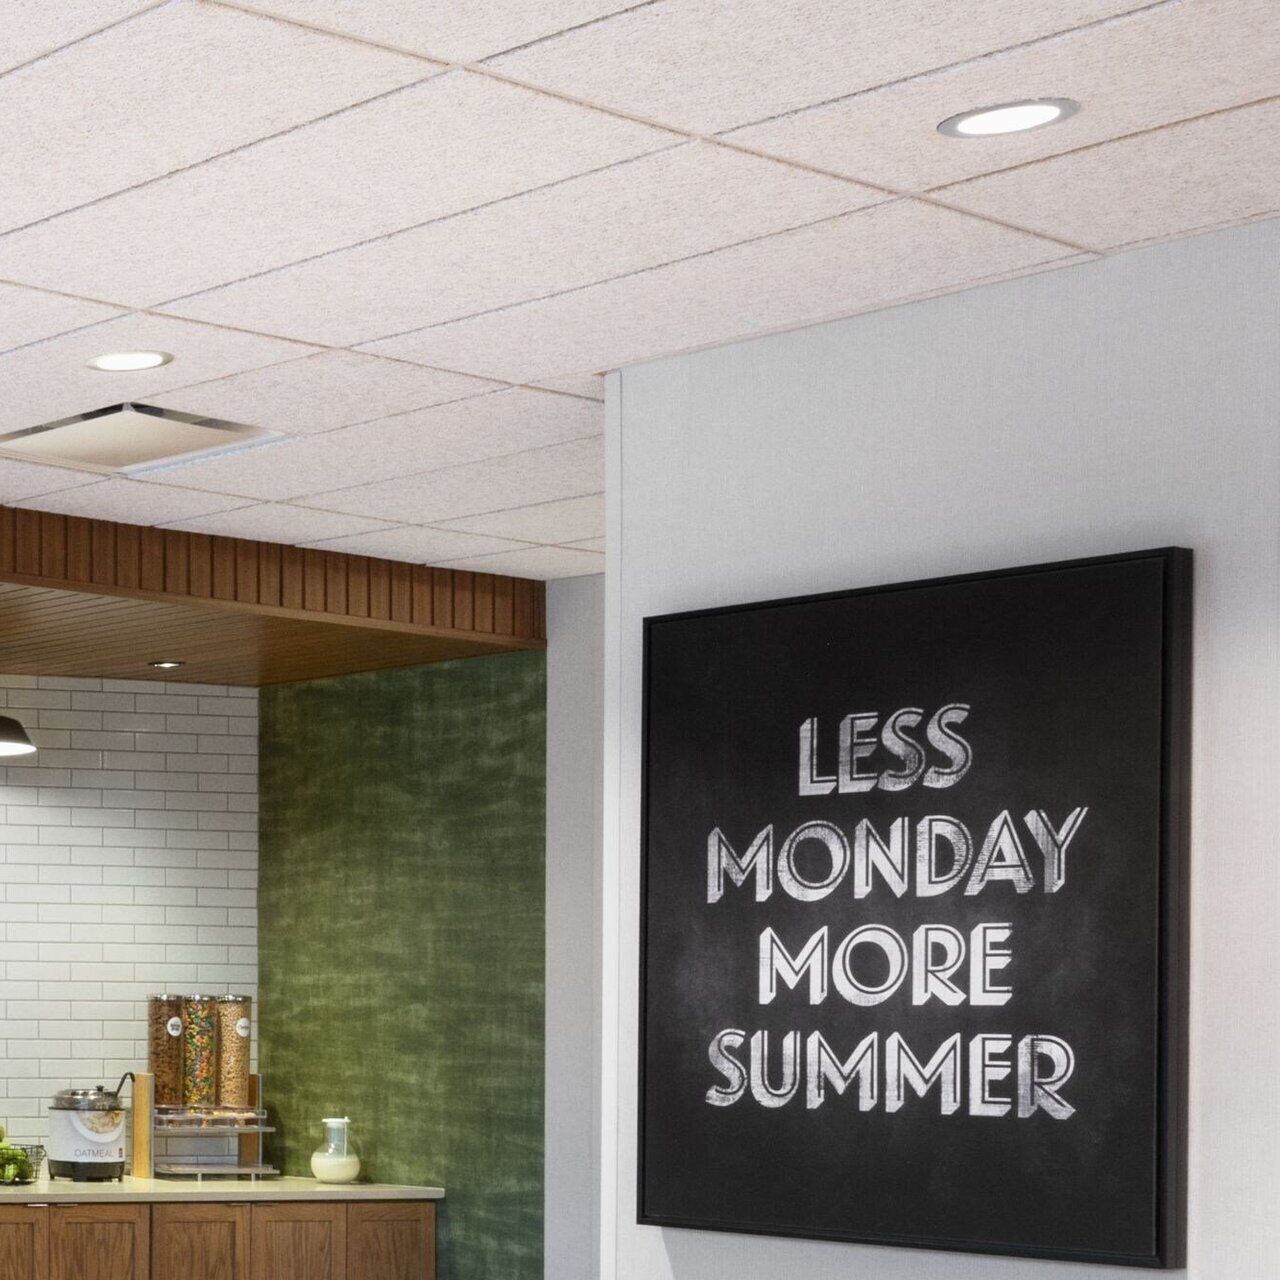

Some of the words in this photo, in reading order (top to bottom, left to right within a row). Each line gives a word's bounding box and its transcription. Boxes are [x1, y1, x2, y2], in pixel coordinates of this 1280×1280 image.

[798, 703, 972, 796] LESS
[706, 806, 1089, 904] MONDAY
[759, 922, 1013, 1007] MORE
[705, 1028, 1077, 1120] SUMMER
[74, 1148, 113, 1158] OATMEAL
